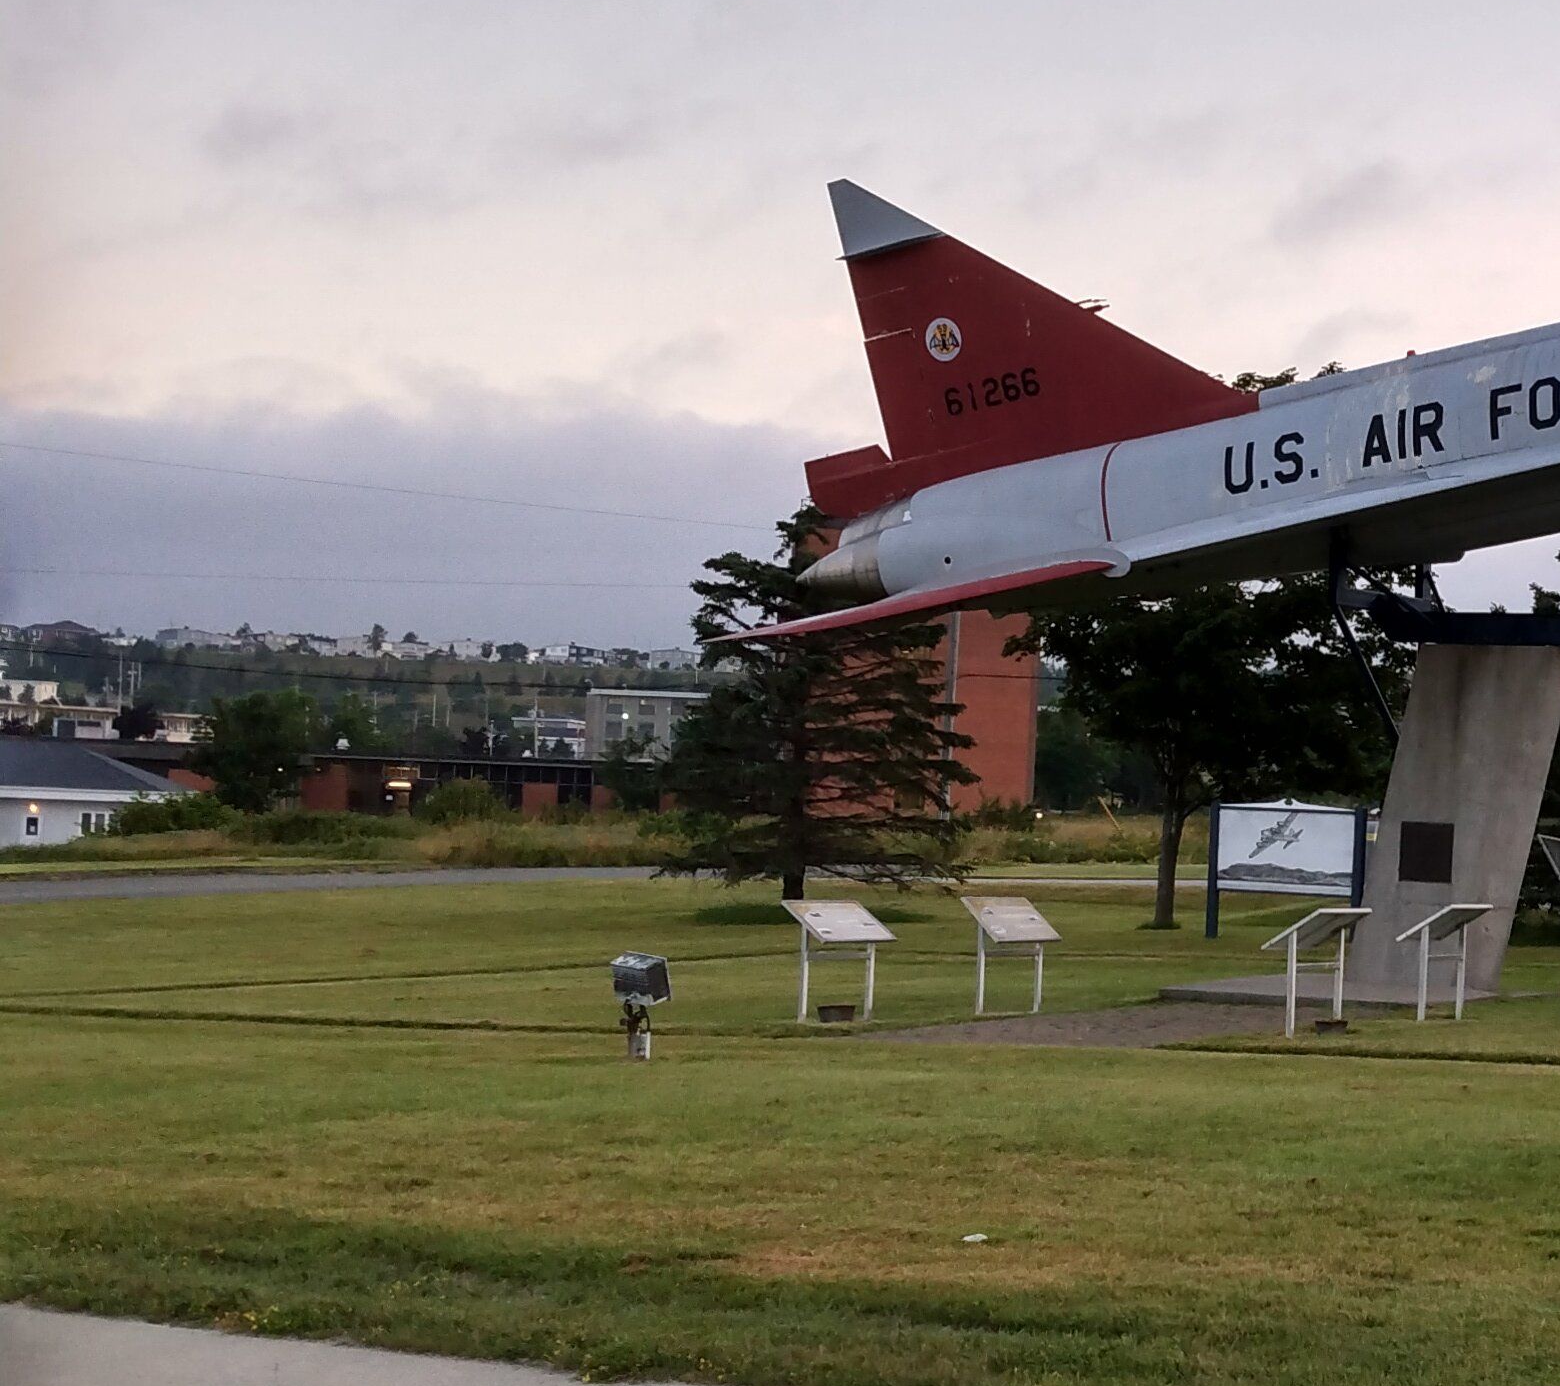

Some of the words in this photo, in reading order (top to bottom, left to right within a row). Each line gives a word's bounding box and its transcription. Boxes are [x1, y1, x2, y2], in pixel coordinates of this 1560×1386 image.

[944, 367, 1040, 415] 61266
[1224, 432, 1319, 494] U.S.
[1362, 401, 1445, 467] AIR
